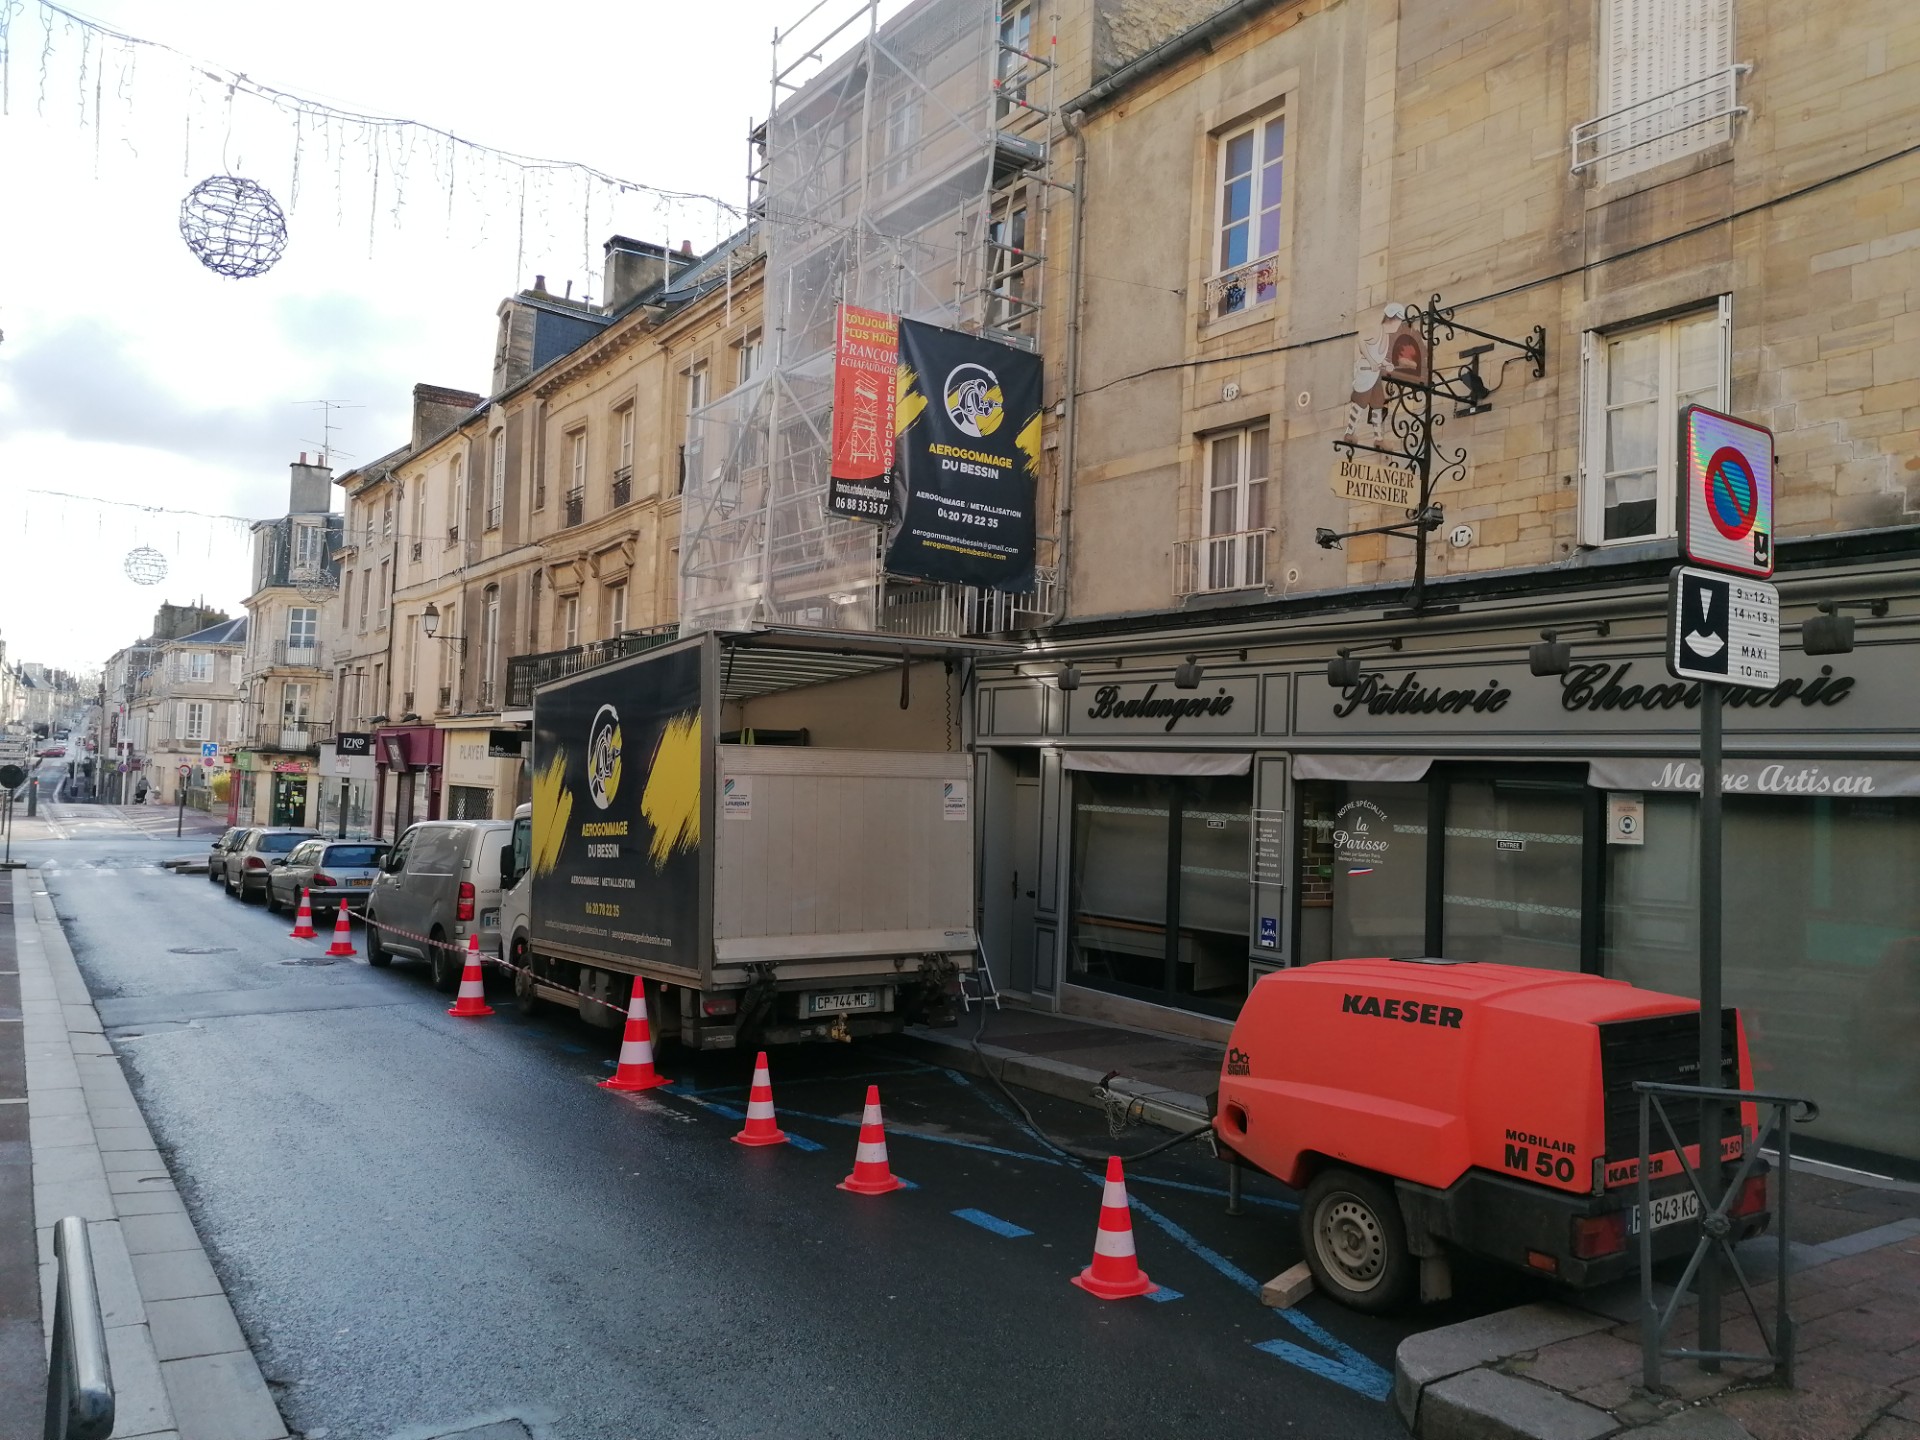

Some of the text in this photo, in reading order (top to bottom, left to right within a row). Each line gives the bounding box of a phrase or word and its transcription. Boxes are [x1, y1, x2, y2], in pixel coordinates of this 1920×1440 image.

[845, 327, 898, 346] PLUS HAUT
[841, 357, 897, 376] ECHAFAUDAGES
[928, 443, 1013, 469] AEROGOMMAGE
[941, 459, 999, 480] DU BESSIN
[1340, 461, 1415, 489] BOULANGER
[1346, 480, 1408, 504] PATISSIER
[835, 497, 889, 516] 06 88 35 35 87
[970, 502, 1022, 518] METALLISATION
[948, 511, 960, 521] 20
[962, 513, 973, 524] 78
[974, 515, 986, 526] 22
[987, 517, 999, 528] 35
[1741, 646, 1767, 660] MAXI
[1740, 665, 1768, 679] 10 mn
[1333, 671, 1512, 718] Pâtisserie
[1560, 662, 1855, 711] Chocoerie
[1088, 683, 1234, 732] Boulangerie
[460, 745, 484, 760] PLAYER
[1652, 762, 1875, 795] Mare Artisan
[1337, 801, 1356, 818] NOTRE
[581, 821, 628, 837] AEROGOMMAGE
[1356, 816, 1369, 831] la
[1333, 830, 1389, 851] Parisse
[587, 844, 619, 858] DU BESSIN
[818, 993, 867, 1010] CP-744-MC
[1342, 993, 1463, 1029] KAESER
[1227, 1064, 1251, 1076] SIGMA
[1505, 1129, 1576, 1155] MOBILAIR
[1505, 1143, 1575, 1183] M 50
[1608, 1160, 1663, 1182] KAEER
[1635, 1193, 1697, 1232] -643-KC
